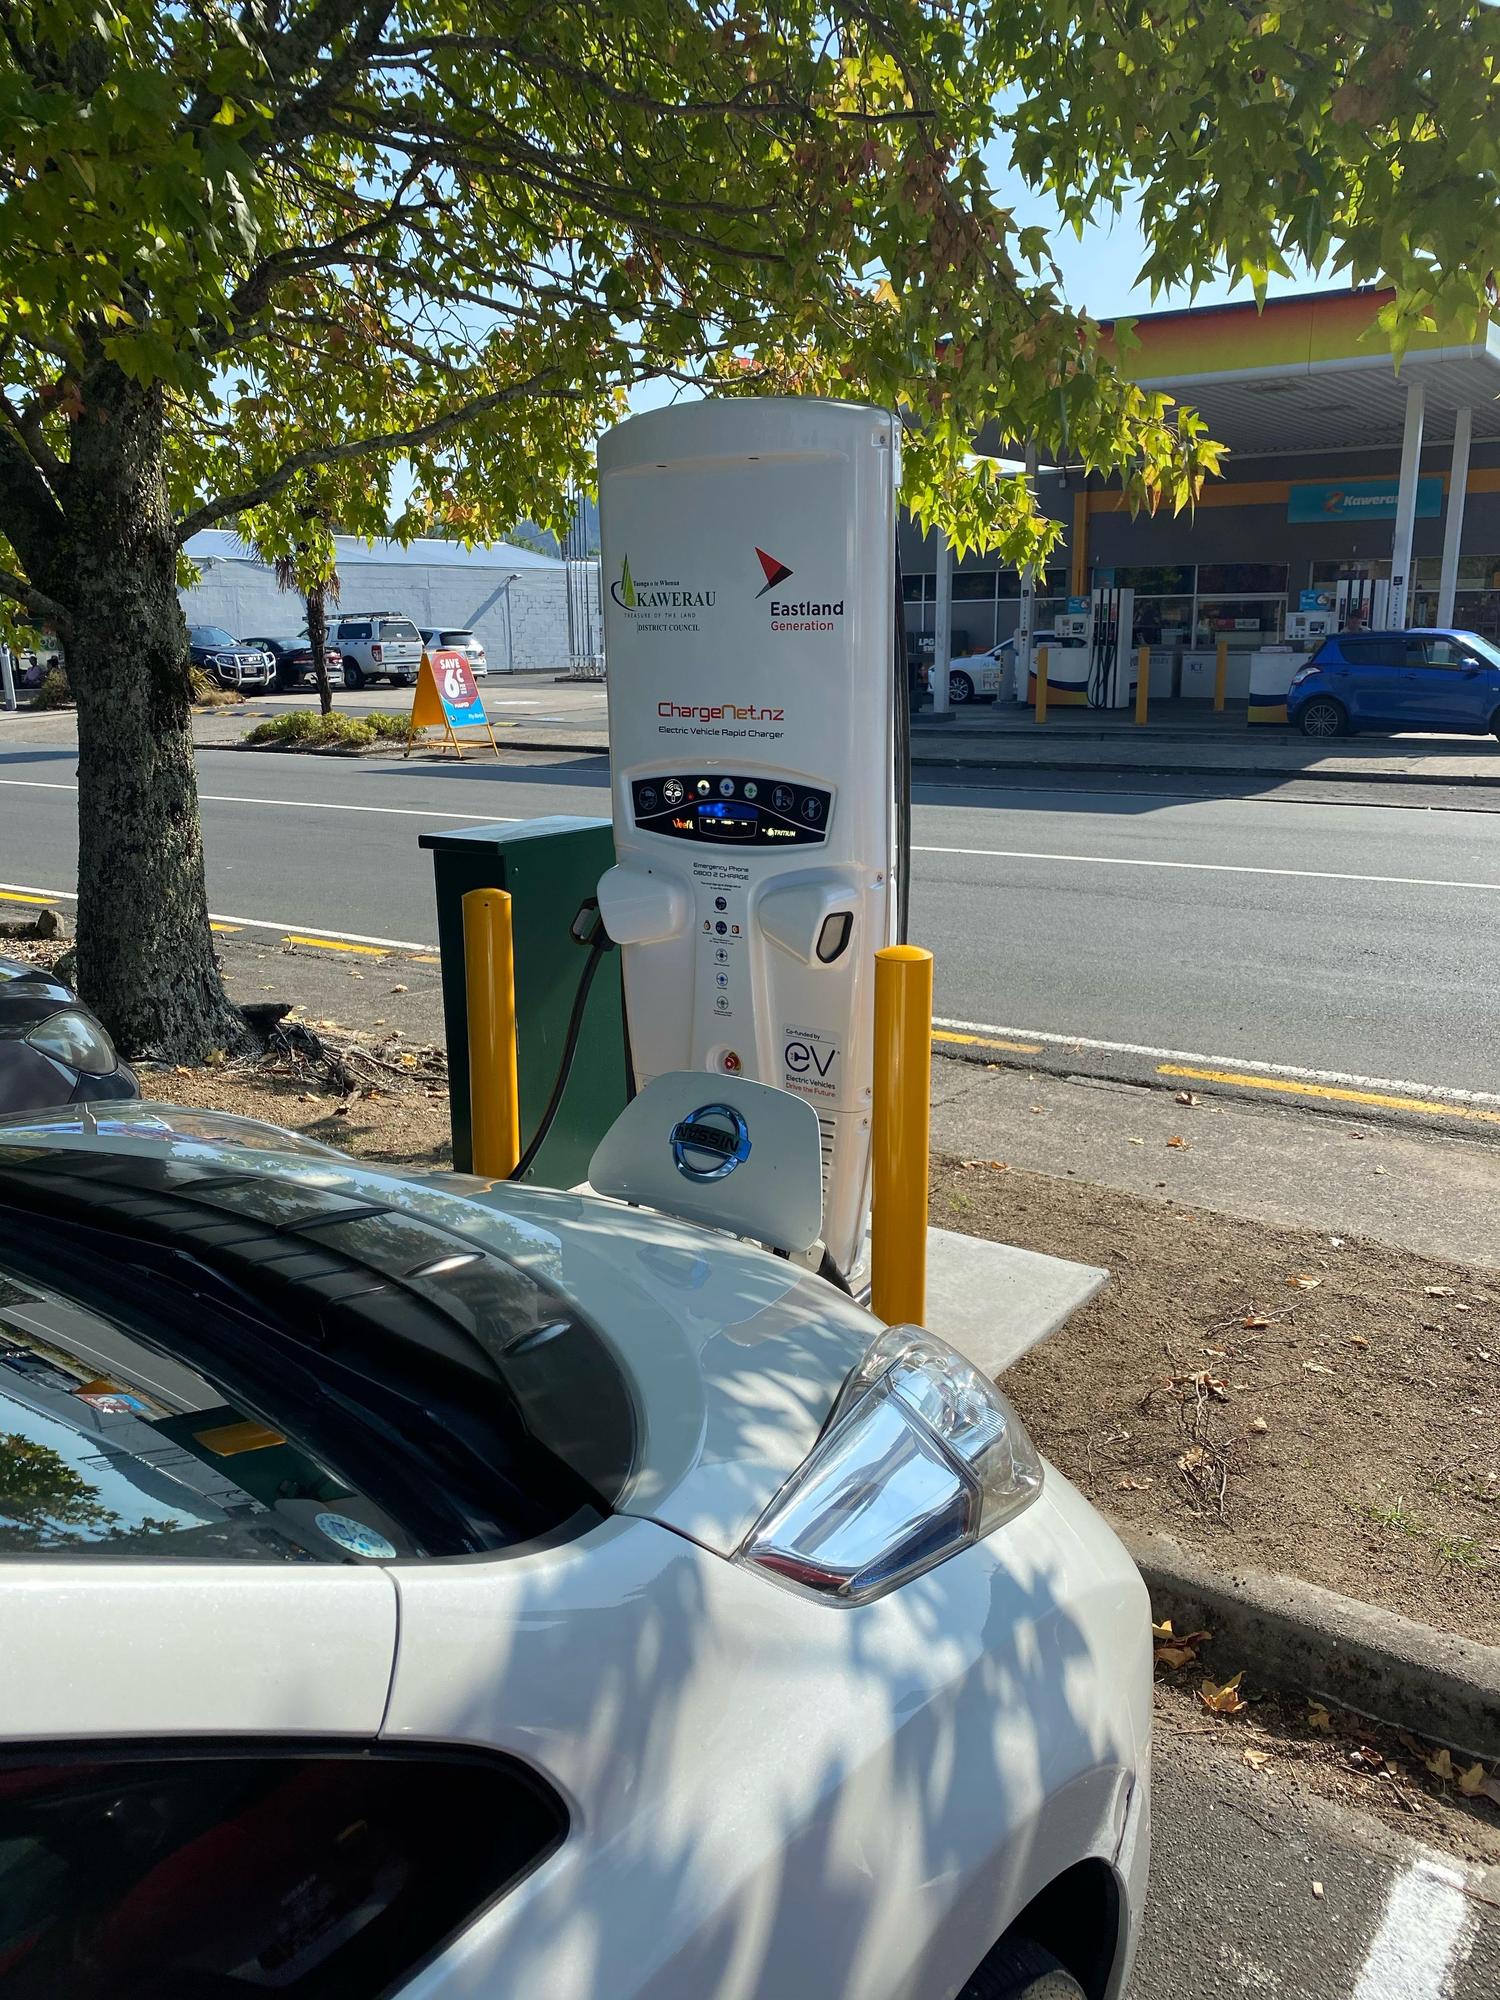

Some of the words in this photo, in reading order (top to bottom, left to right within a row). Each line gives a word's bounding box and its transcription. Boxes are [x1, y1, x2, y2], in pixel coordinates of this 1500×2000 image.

[636, 591, 716, 607] KAWERAU
[770, 601, 844, 617] Eastland
[638, 624, 667, 632] DISTRICT
[668, 624, 700, 632] COUNCIL
[770, 620, 834, 631] Generation
[918, 638, 935, 646] LPG
[440, 658, 460, 670] SAVE
[658, 702, 785, 722] ChargeNet.nz
[658, 726, 688, 735] Electric
[690, 727, 720, 736] Vehicle
[721, 728, 746, 738] Rapid
[748, 729, 784, 739] Charger
[693, 862, 727, 871] Emergency
[719, 872, 749, 880] CHARGE
[785, 1028, 812, 1039] Co-funded
[813, 1032, 820, 1040] by
[786, 1074, 809, 1085] Electric
[809, 1078, 836, 1089] Vehicles
[785, 1082, 802, 1093] Drive
[803, 1085, 813, 1093] the
[814, 1087, 836, 1098] Future
